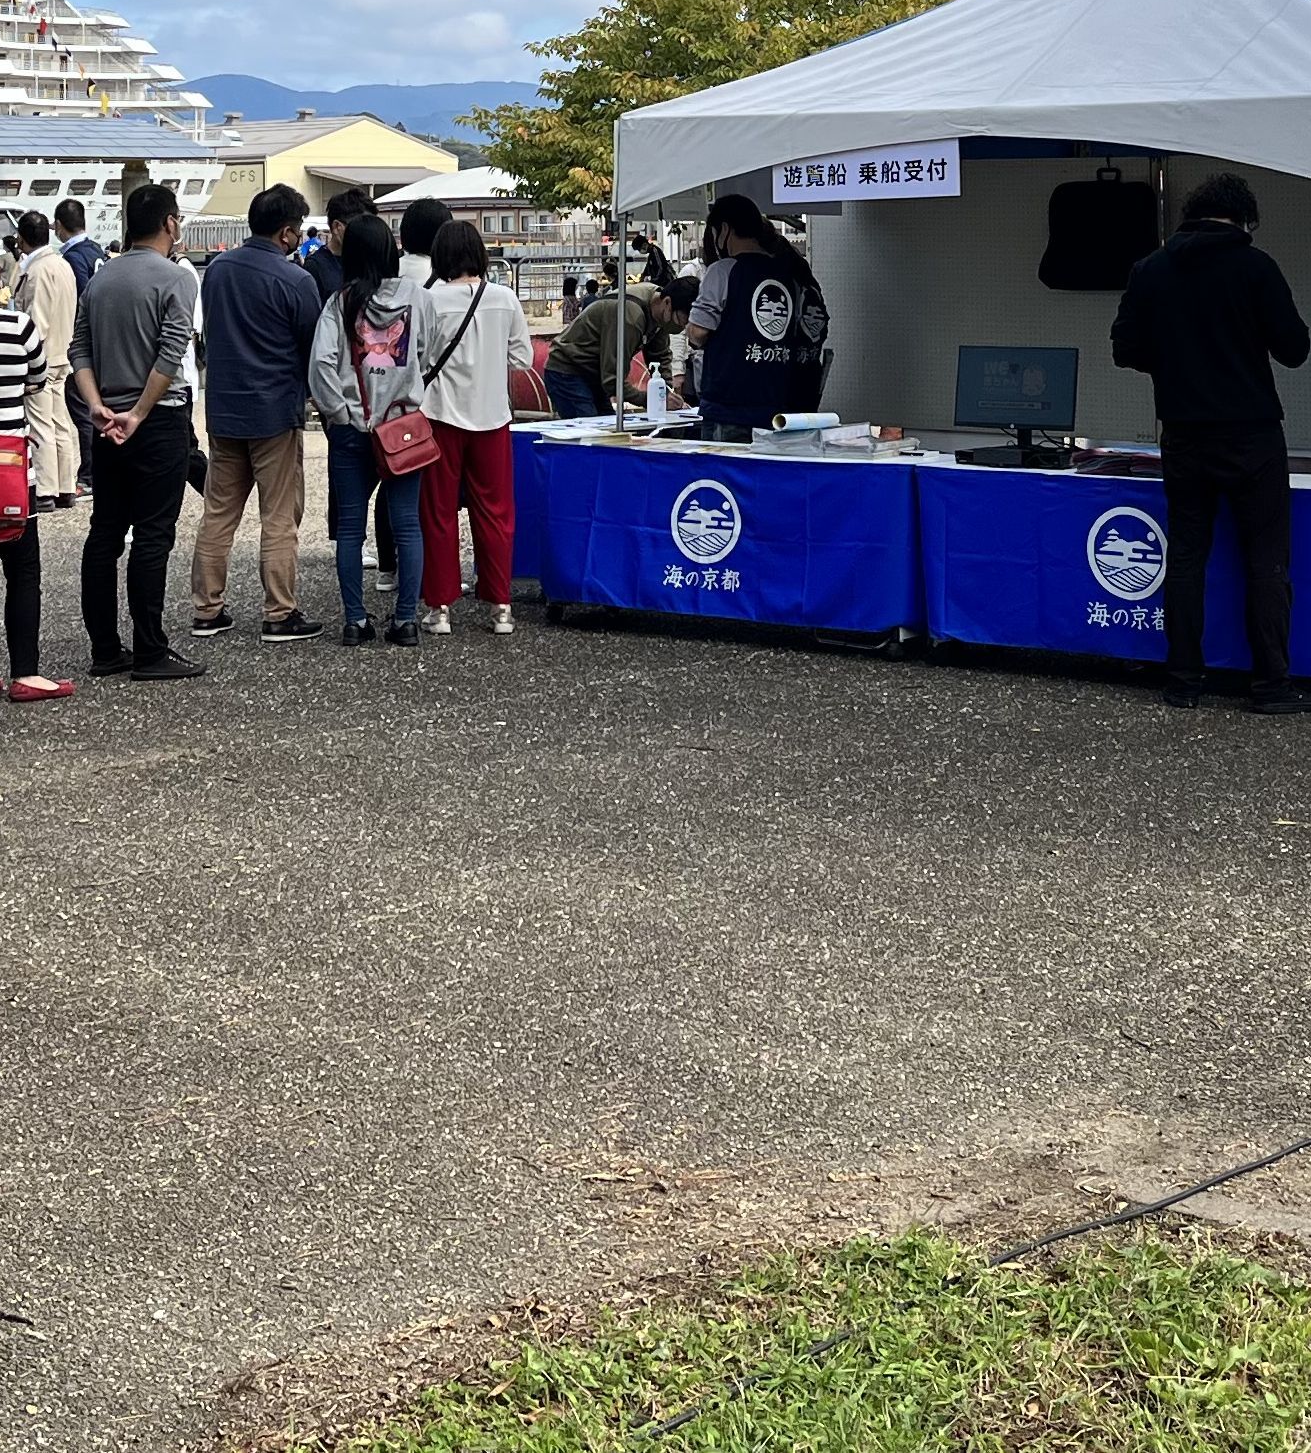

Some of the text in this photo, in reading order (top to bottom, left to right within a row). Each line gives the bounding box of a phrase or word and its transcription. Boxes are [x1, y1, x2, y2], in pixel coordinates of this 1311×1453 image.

[229, 169, 256, 183] CFS
[783, 157, 948, 188] 遊覧船 乗船受付
[95, 223, 120, 233] ASUK
[369, 366, 386, 375] Ado
[662, 564, 740, 593] 海の京都
